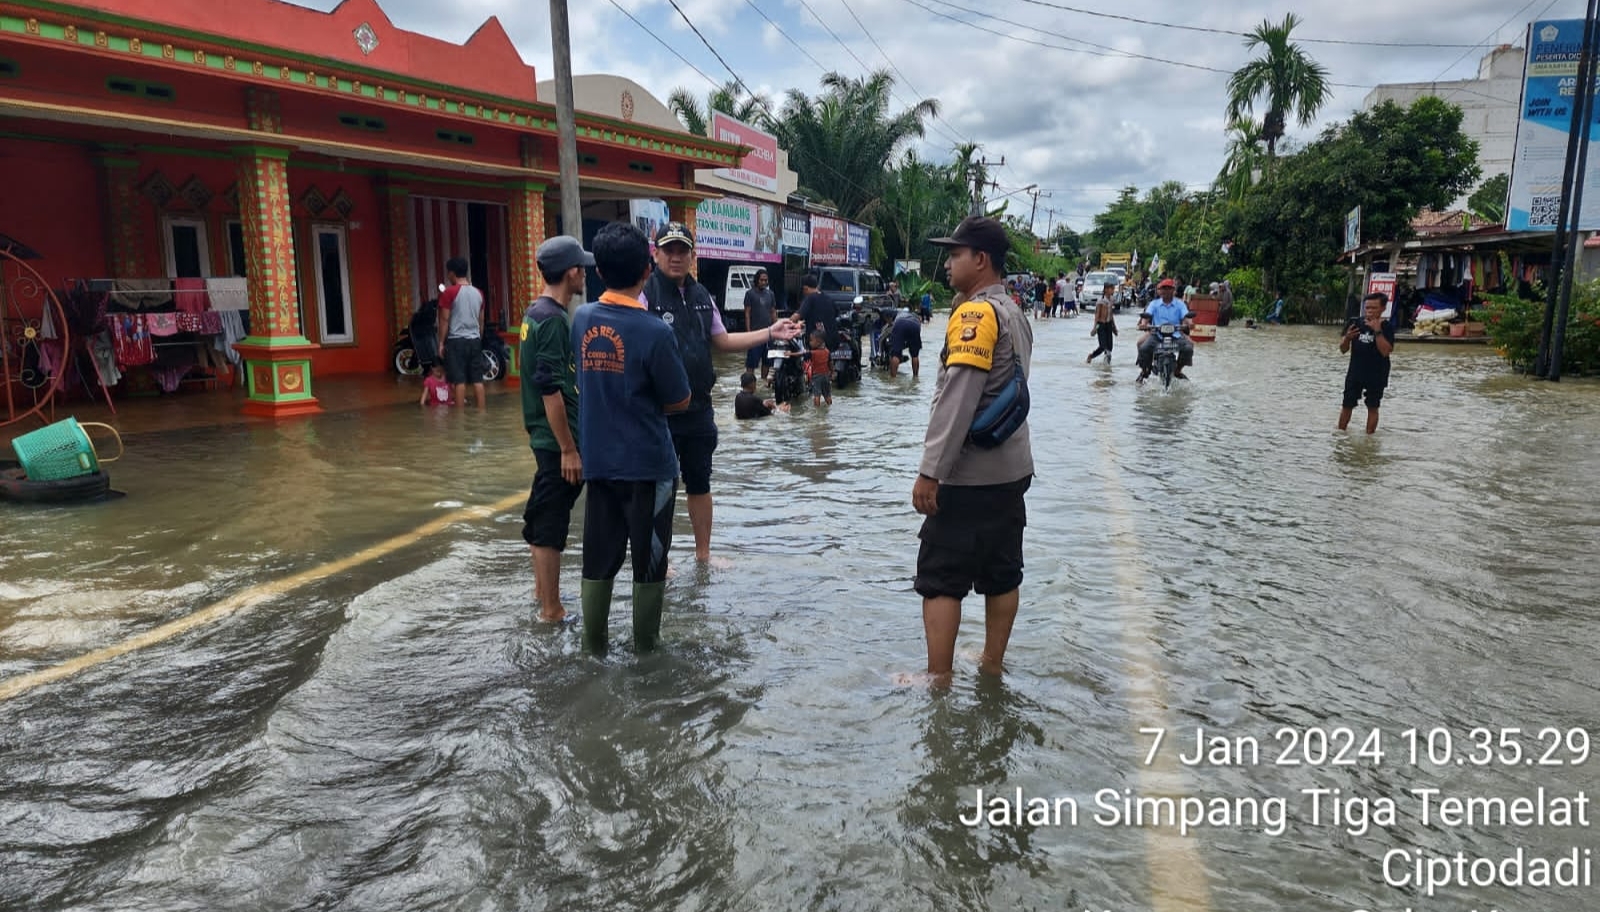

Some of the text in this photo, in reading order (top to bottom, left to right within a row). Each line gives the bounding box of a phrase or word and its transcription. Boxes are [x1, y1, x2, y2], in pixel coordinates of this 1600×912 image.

[1536, 53, 1567, 61] PESERTA
[1529, 99, 1551, 107] JOIN
[1528, 108, 1567, 116] WITH US
[711, 200, 751, 220] BAMBANG
